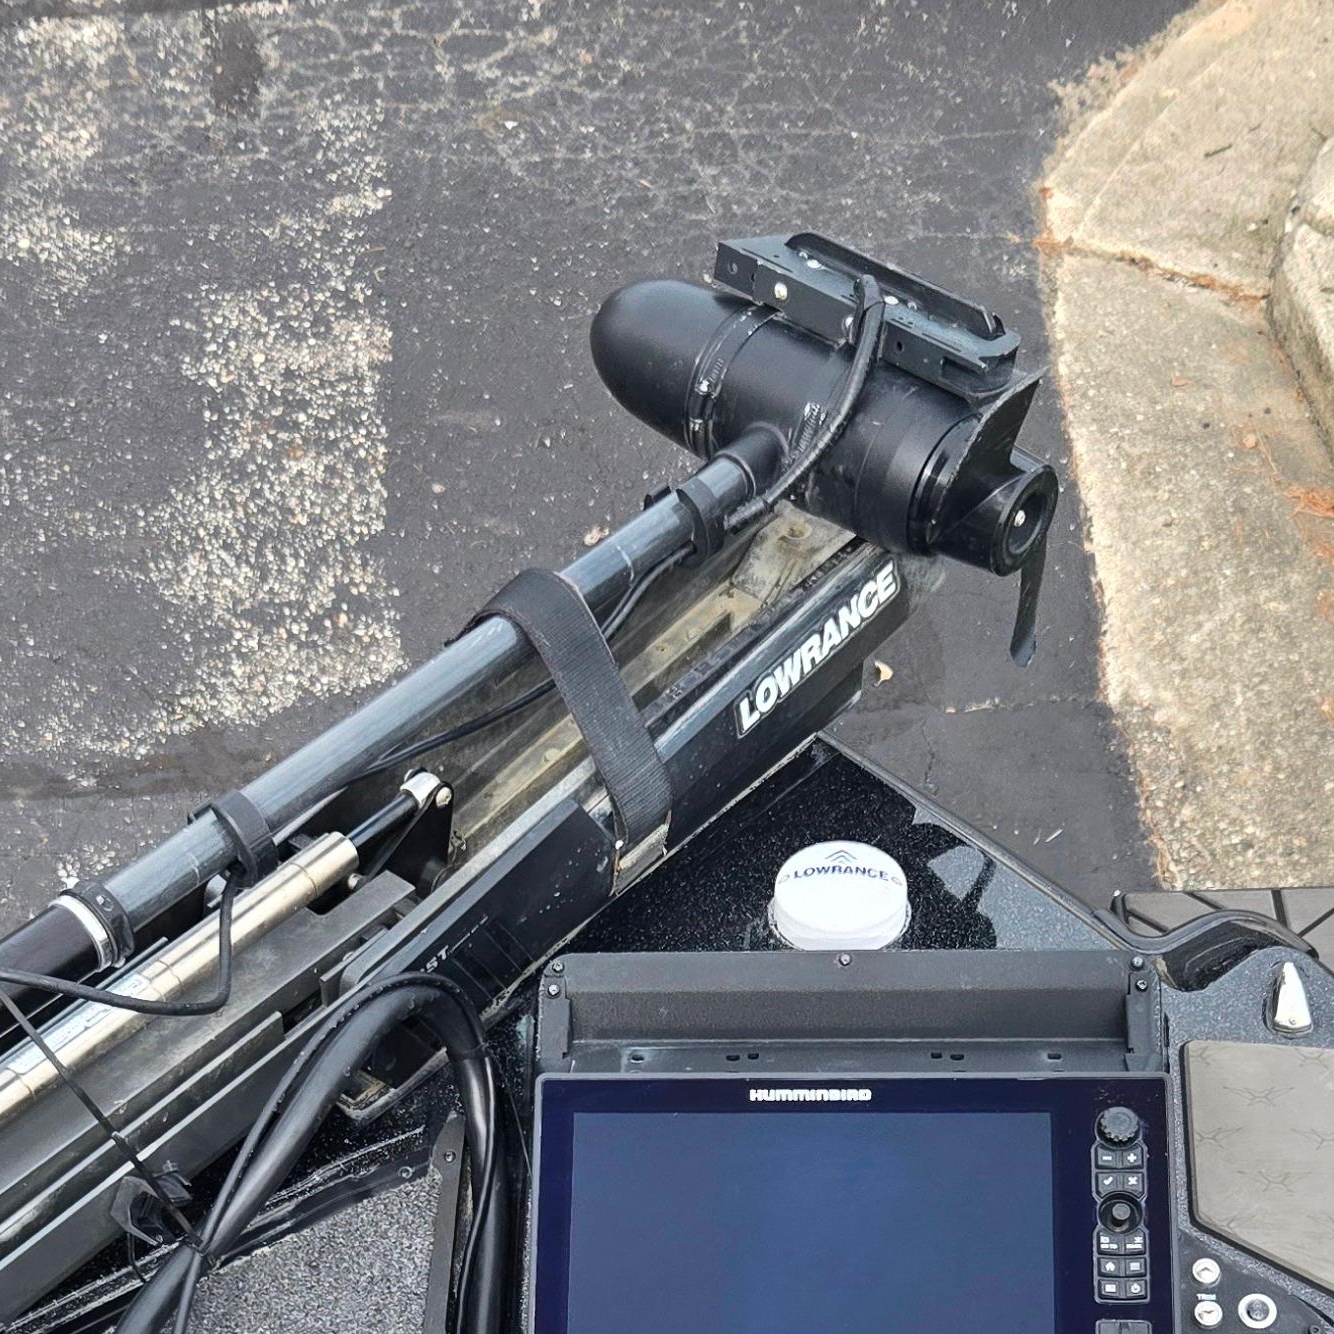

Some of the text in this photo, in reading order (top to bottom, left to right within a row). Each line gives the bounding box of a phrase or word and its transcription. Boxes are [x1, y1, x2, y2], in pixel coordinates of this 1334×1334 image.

[738, 559, 897, 734] LOWRANCE
[793, 864, 890, 882] LOWRANCE
[749, 1088, 873, 1102] HUMMINBIRD
